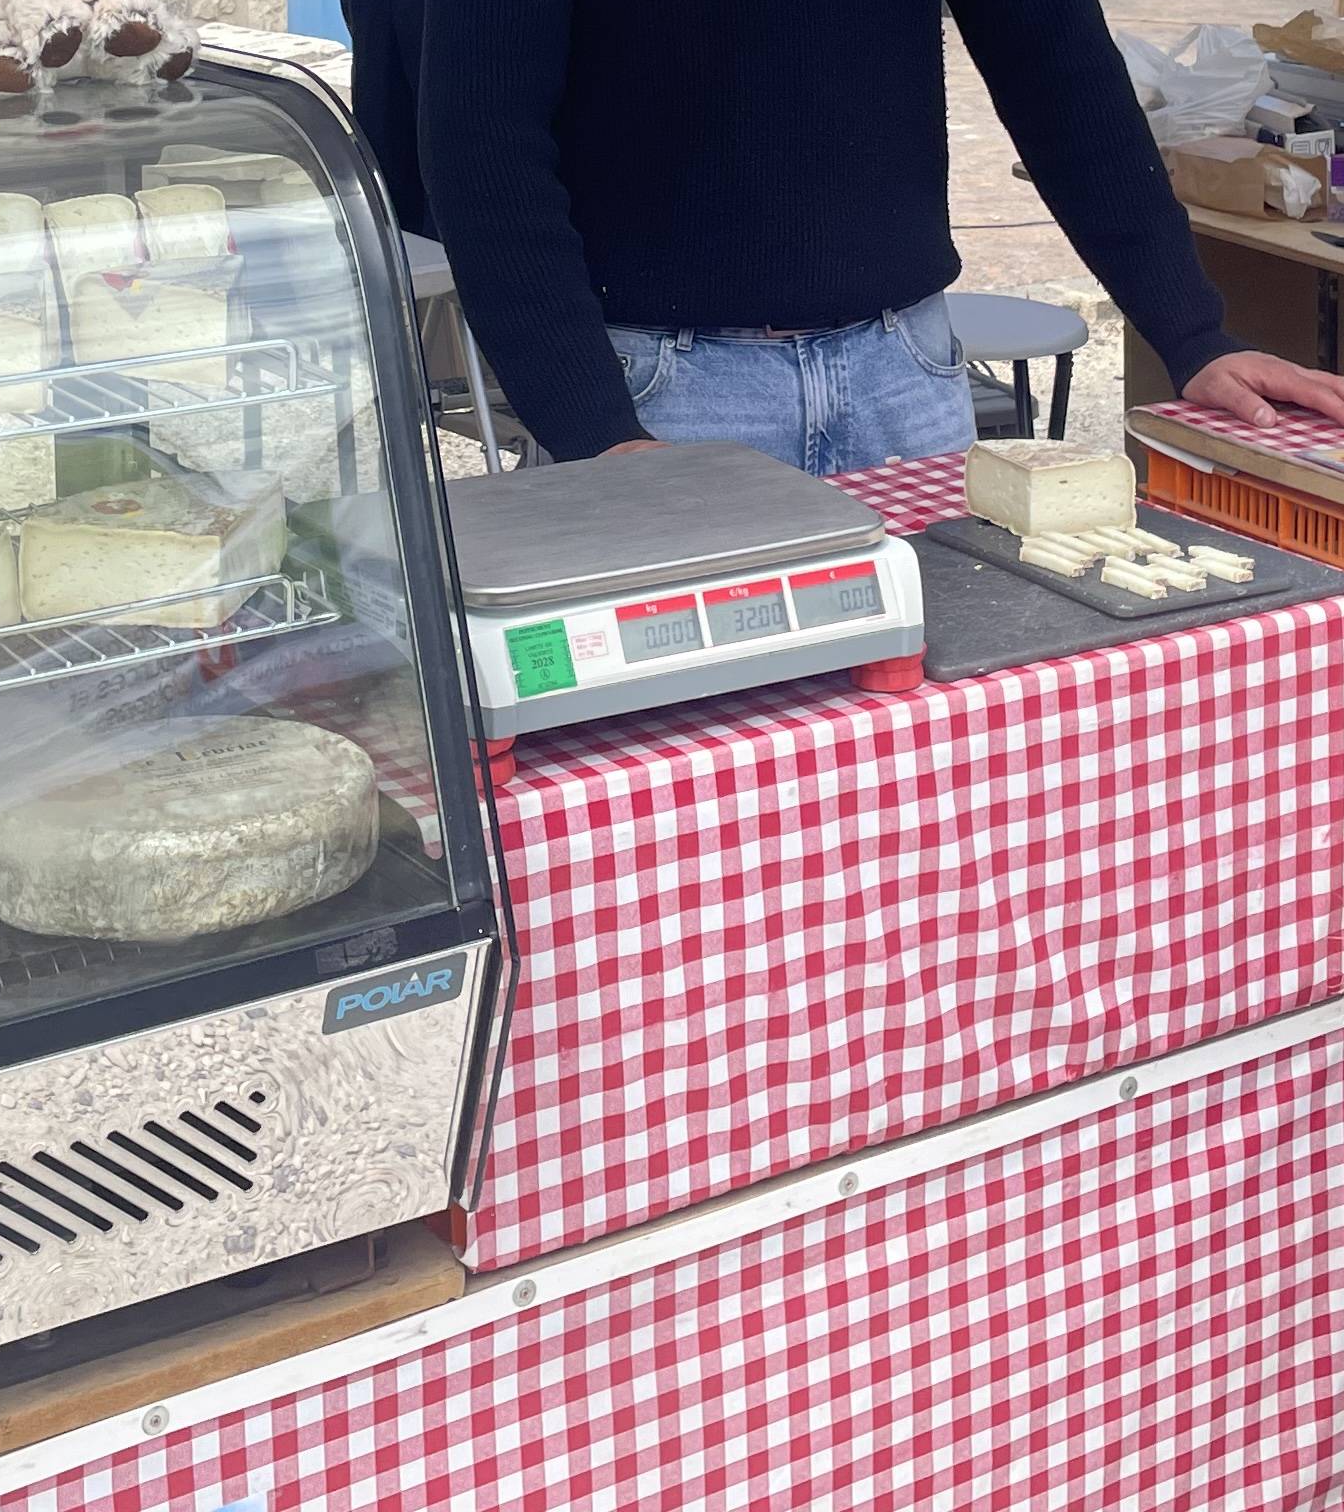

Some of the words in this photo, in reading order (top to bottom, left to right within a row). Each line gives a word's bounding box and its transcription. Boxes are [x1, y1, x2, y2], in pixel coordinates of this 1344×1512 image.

[829, 571, 836, 580] €
[729, 586, 750, 599] €/kg
[645, 603, 658, 615] kg
